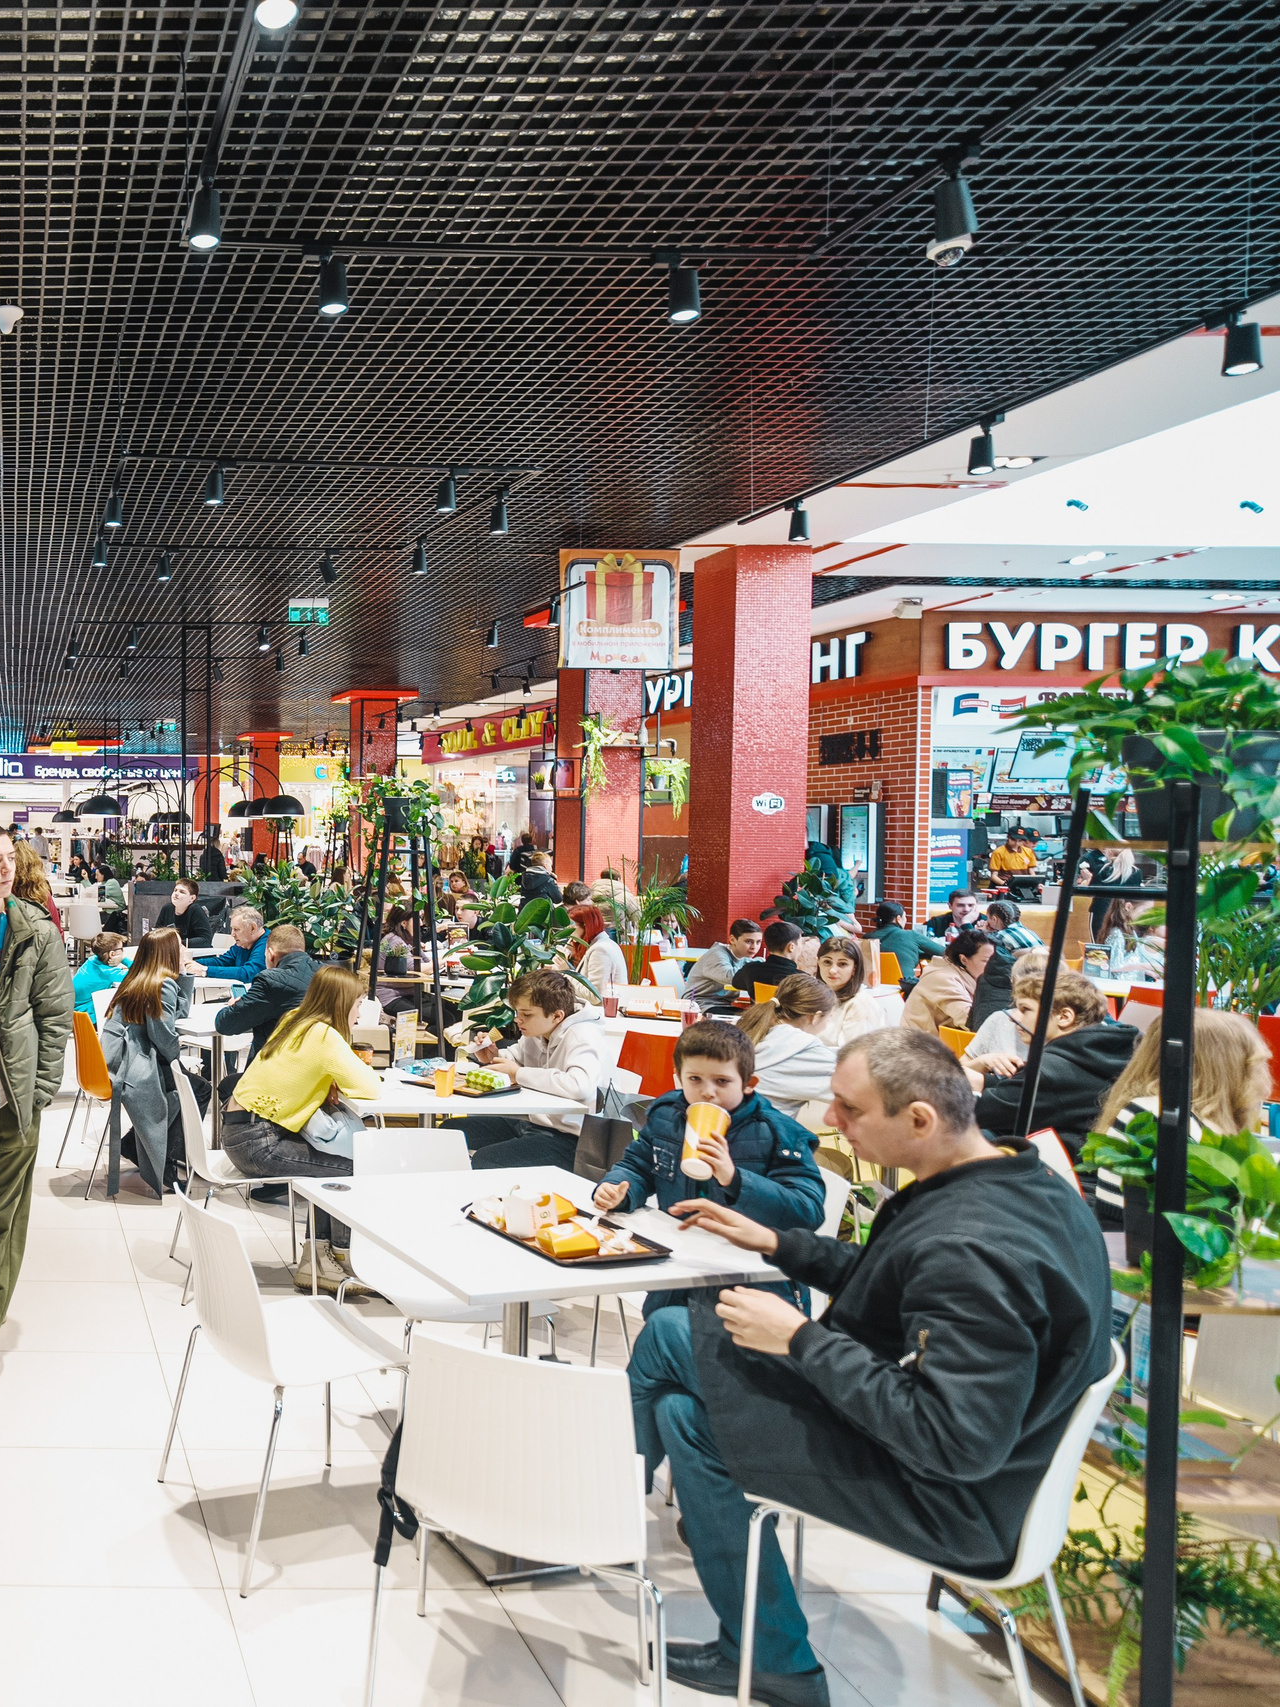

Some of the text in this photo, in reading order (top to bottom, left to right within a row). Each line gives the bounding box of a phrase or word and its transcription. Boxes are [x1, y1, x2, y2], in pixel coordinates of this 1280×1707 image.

[579, 623, 660, 636] Комплименты
[577, 639, 620, 648] мобильном
[621, 641, 667, 649] приложении
[946, 621, 1209, 672] БУРГЕР
[811, 631, 868, 684] НГ
[481, 721, 497, 746] &
[34, 766, 80, 779] Бренды,
[930, 840, 962, 848] очешь
[930, 848, 962, 856] есплатно
